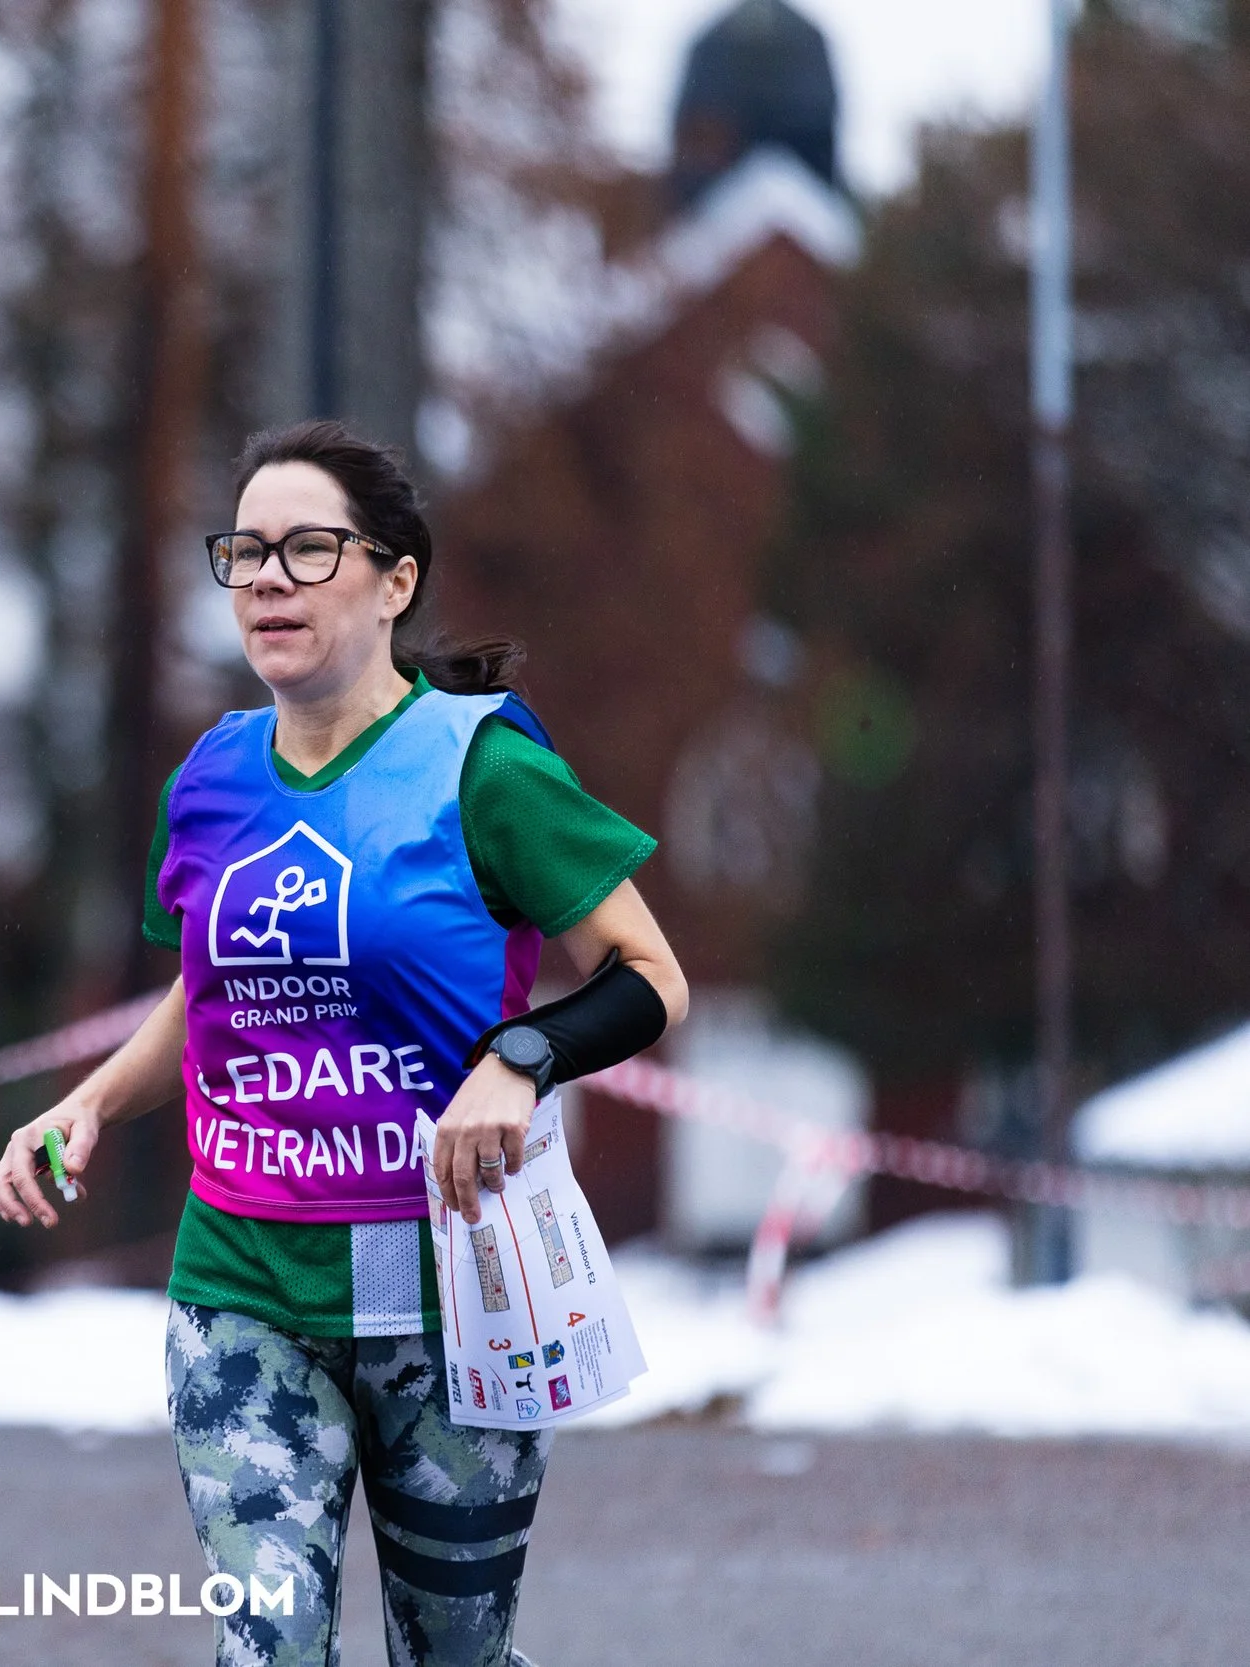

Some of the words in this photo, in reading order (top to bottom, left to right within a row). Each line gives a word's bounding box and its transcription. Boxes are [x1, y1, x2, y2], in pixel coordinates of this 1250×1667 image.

[225, 976, 351, 1002] INDOOR
[230, 1006, 308, 1029] GRAND
[315, 1003, 359, 1019] PRIX
[196, 1044, 434, 1105] LEDARE
[196, 1117, 364, 1178] VETERAN
[570, 1211, 582, 1240] Viken
[579, 1240, 591, 1270] Indoor
[587, 1271, 596, 1285] E2
[567, 1312, 586, 1327] 4
[488, 1338, 511, 1351] 3
[450, 1361, 463, 1405] TRIMTEX
